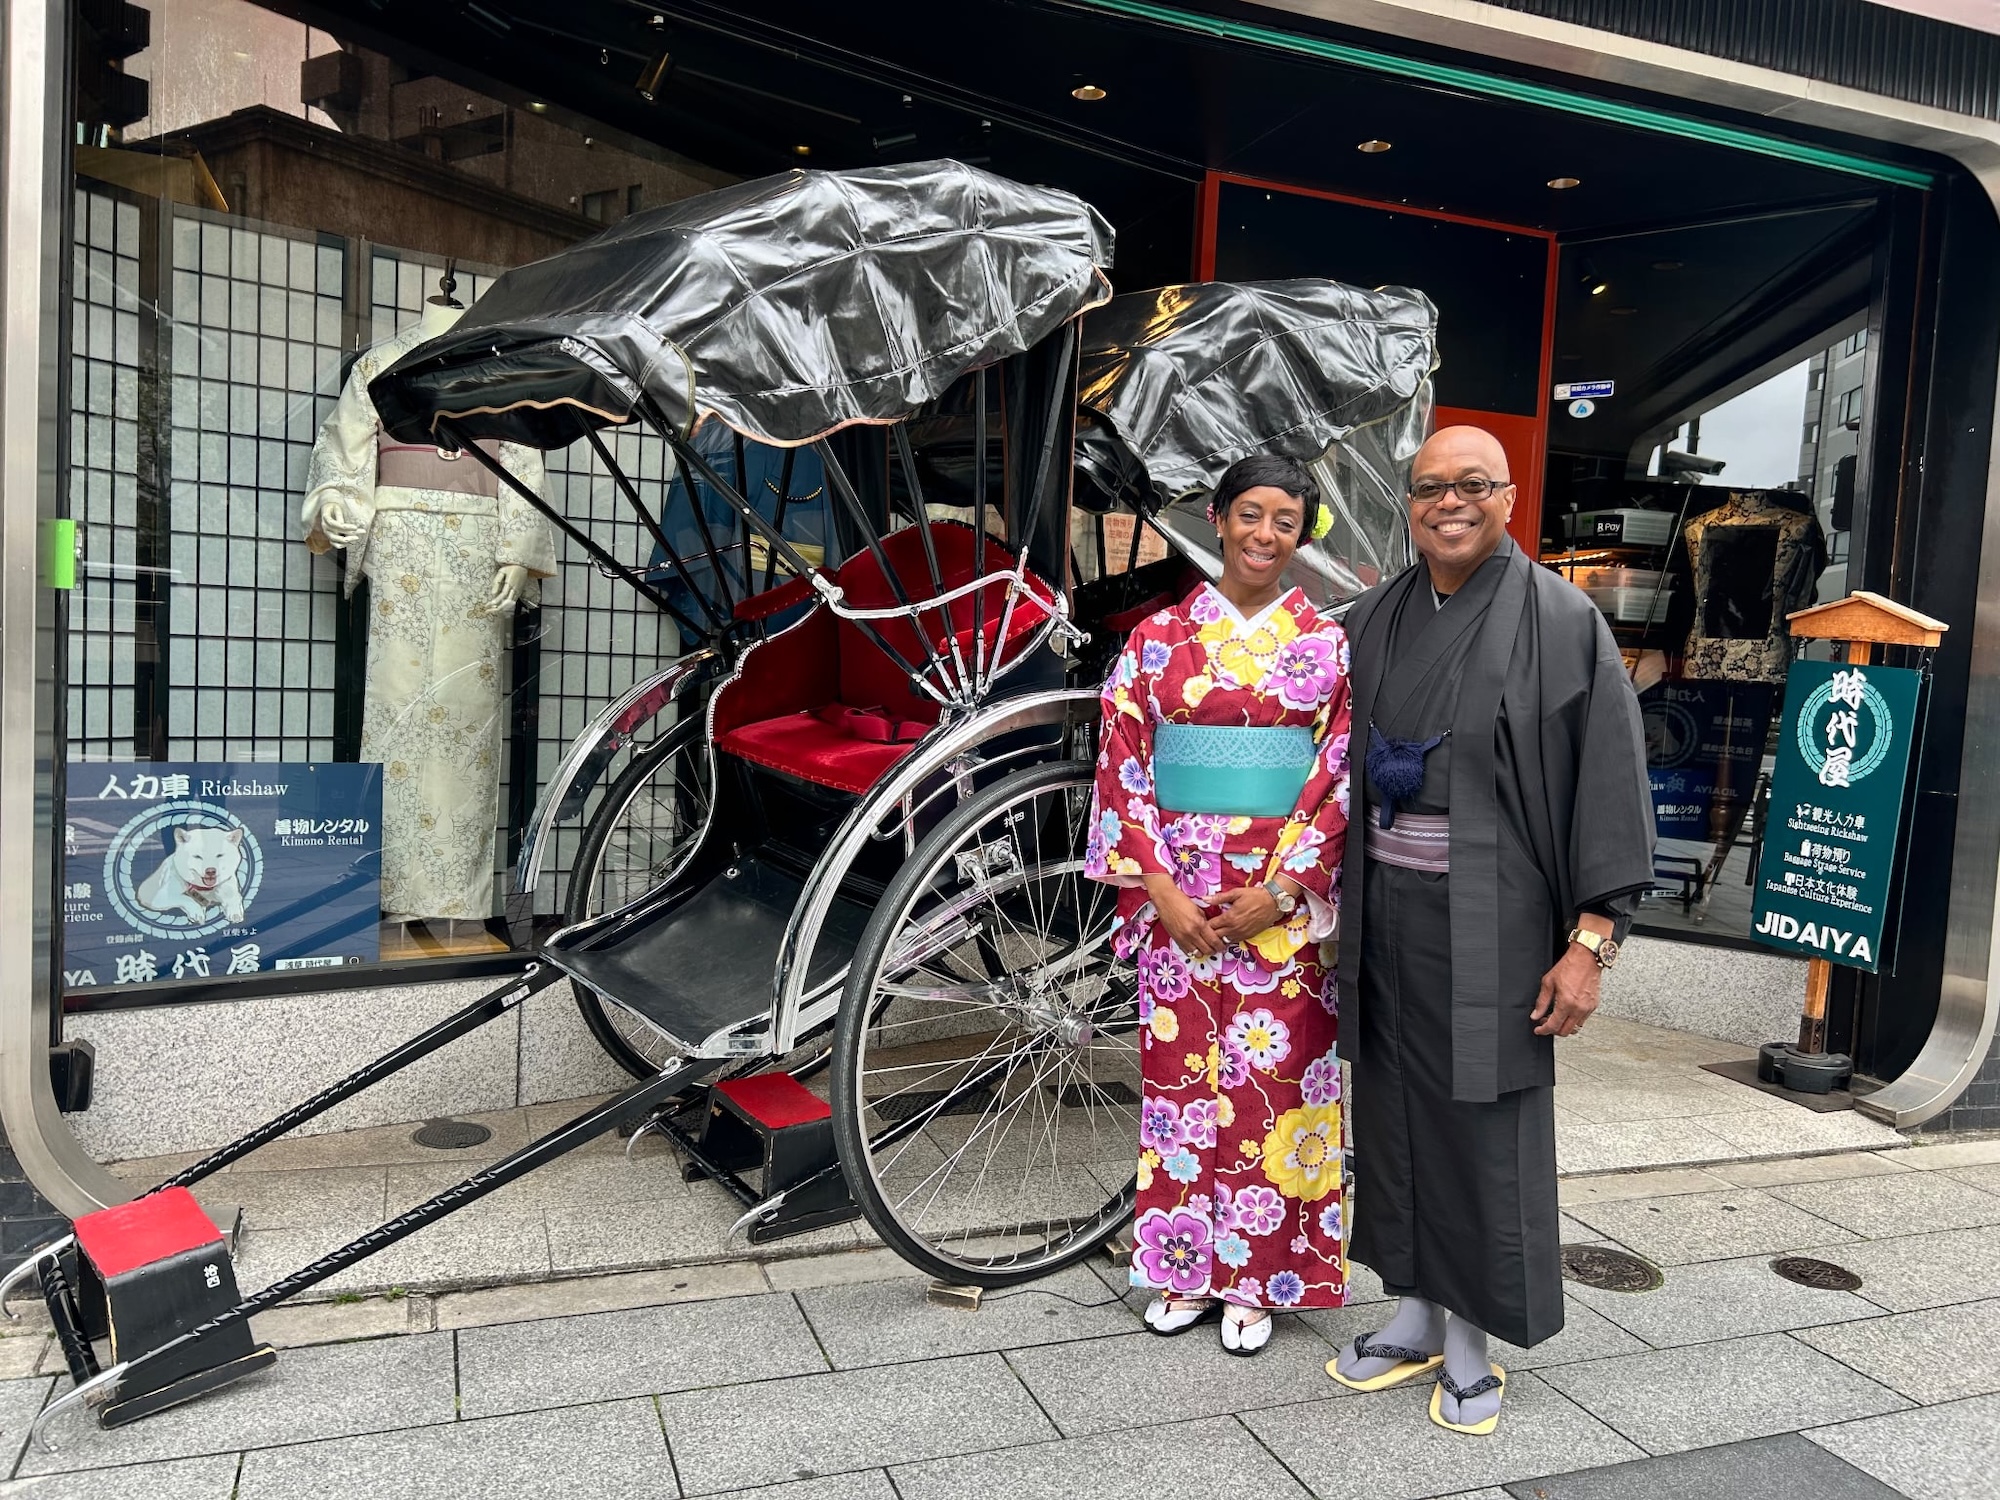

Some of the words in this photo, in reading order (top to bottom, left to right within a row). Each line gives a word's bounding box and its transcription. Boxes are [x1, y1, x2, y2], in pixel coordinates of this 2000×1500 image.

[1605, 522, 1621, 532] Pay
[1819, 667, 1867, 788] 時代屋
[98, 773, 190, 800] 人力車
[201, 779, 290, 797] Rickshaw
[274, 818, 370, 835] 着物レンタル
[1787, 817, 1830, 836] Sightseeing
[1830, 826, 1869, 843] Rickshaw
[1811, 806, 1866, 830] 観光人力車
[281, 835, 324, 847] Kimono
[327, 834, 363, 846] Rental
[1811, 843, 1851, 864] 荷物預り
[1783, 851, 1812, 868] Baggage
[1837, 864, 1867, 879] Service
[1765, 879, 1798, 896] Japanese
[1799, 887, 1830, 904] Culture
[1830, 895, 1873, 914] Experience
[1795, 874, 1859, 901] 日本文化体験
[1755, 911, 1873, 962] JIDAIYA
[113, 943, 261, 984] 時代屋
